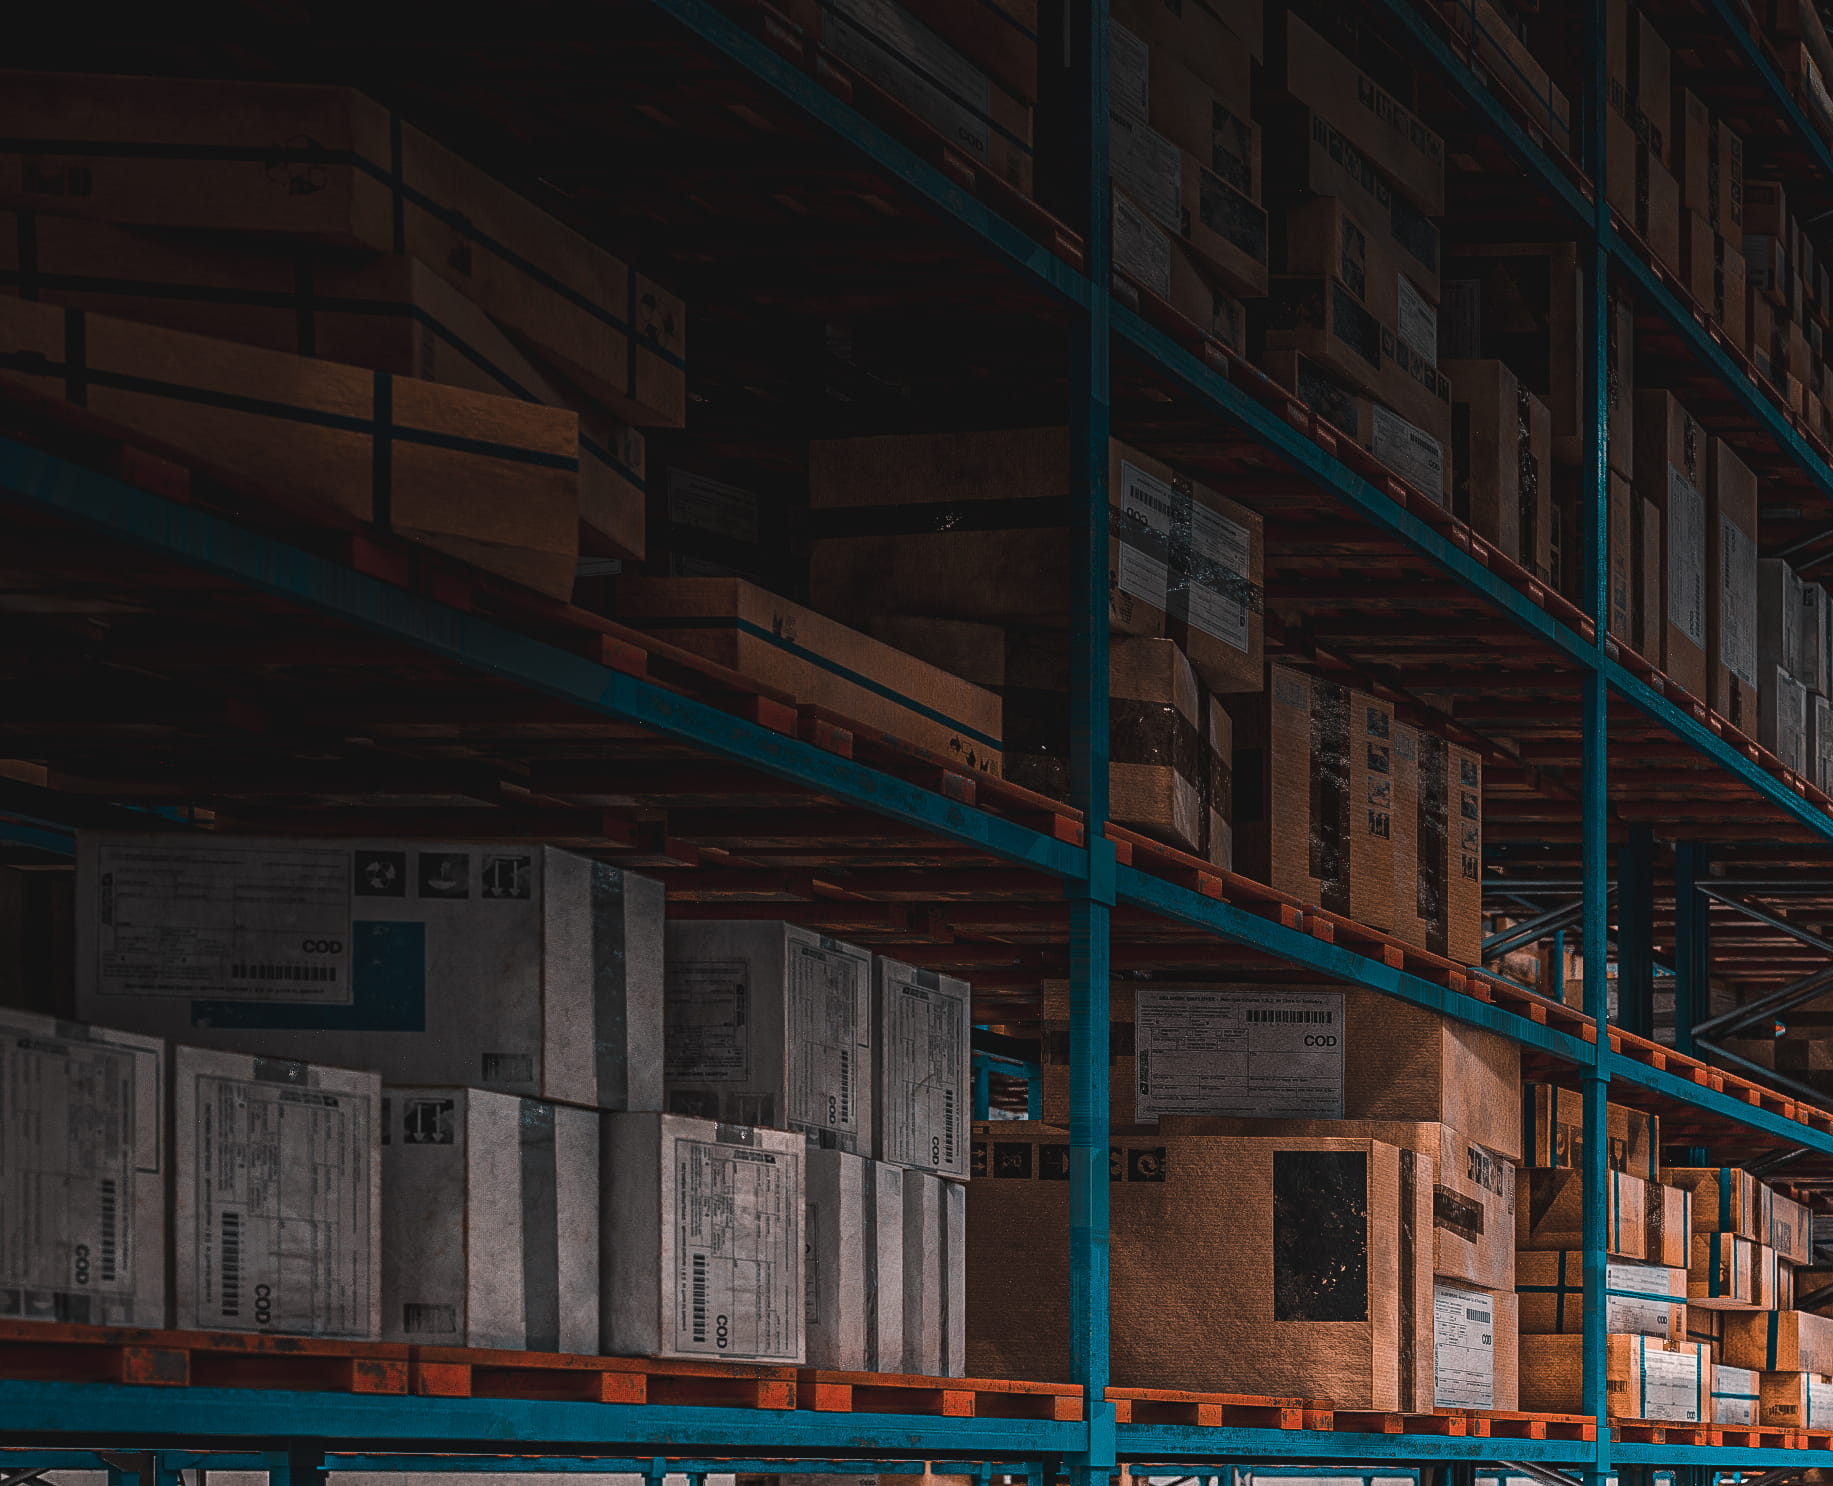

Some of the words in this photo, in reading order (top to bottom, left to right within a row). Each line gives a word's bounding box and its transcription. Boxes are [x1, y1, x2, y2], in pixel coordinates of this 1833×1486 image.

[960, 128, 983, 151] COD
[302, 939, 342, 954] COD
[1304, 1035, 1337, 1046] COD
[75, 1244, 89, 1285] COD
[255, 1284, 272, 1326] COD
[1657, 1315, 1667, 1325] COD
[716, 1315, 728, 1348] COD
[1482, 1334, 1491, 1345] COD
